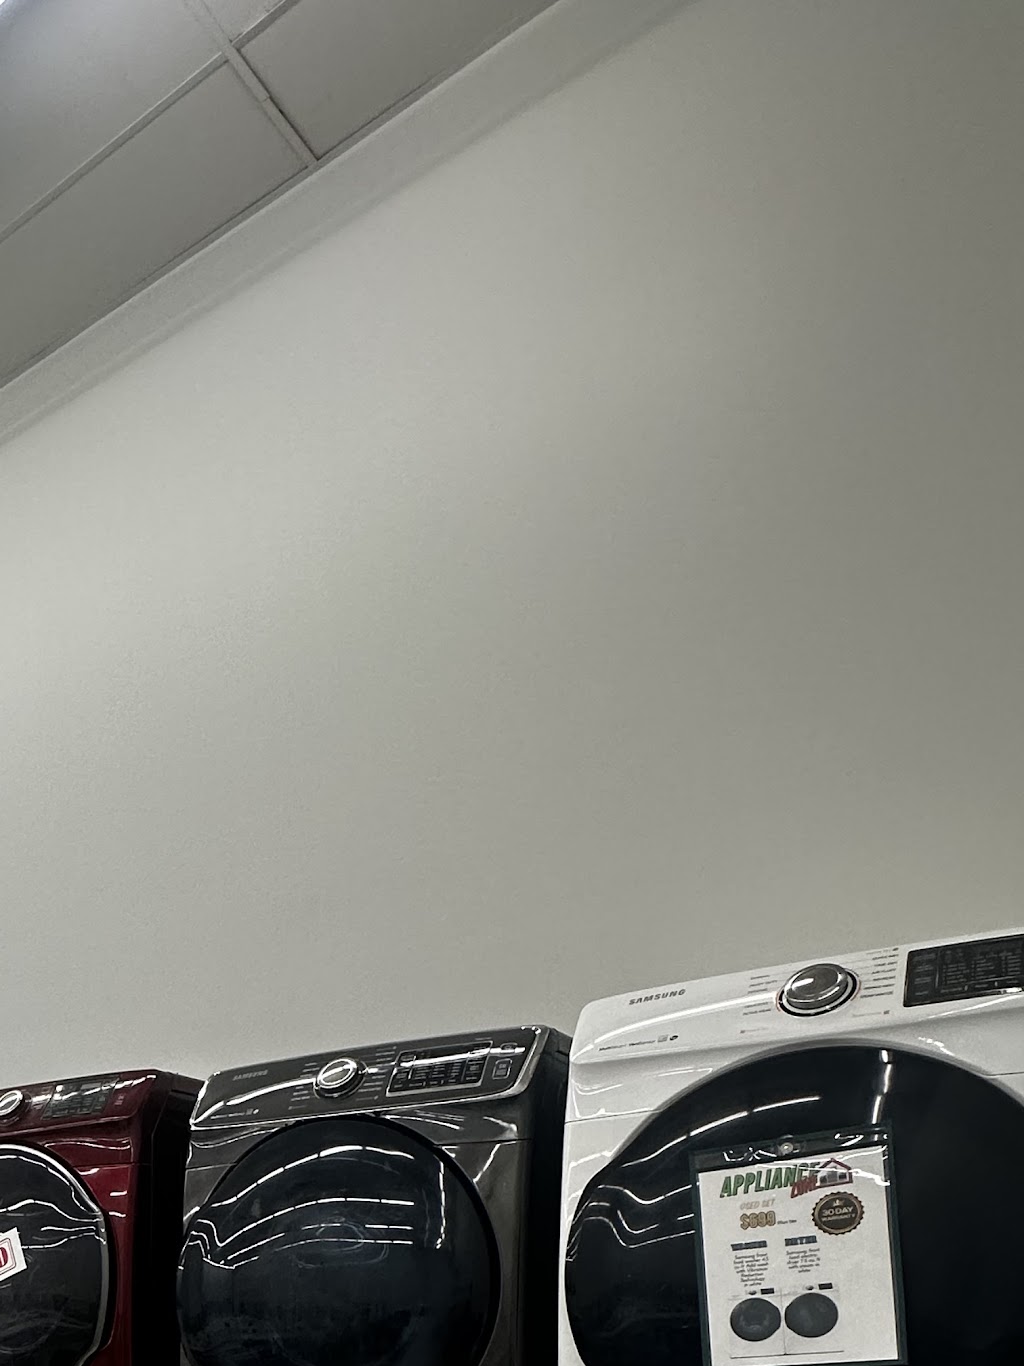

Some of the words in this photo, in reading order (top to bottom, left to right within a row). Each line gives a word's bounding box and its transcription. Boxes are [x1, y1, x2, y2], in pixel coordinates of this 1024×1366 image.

[628, 988, 686, 1006] SAMSUNG
[719, 1161, 821, 1199] APPLIANCE
[822, 1207, 835, 1217] 30
[835, 1206, 854, 1215] DAY
